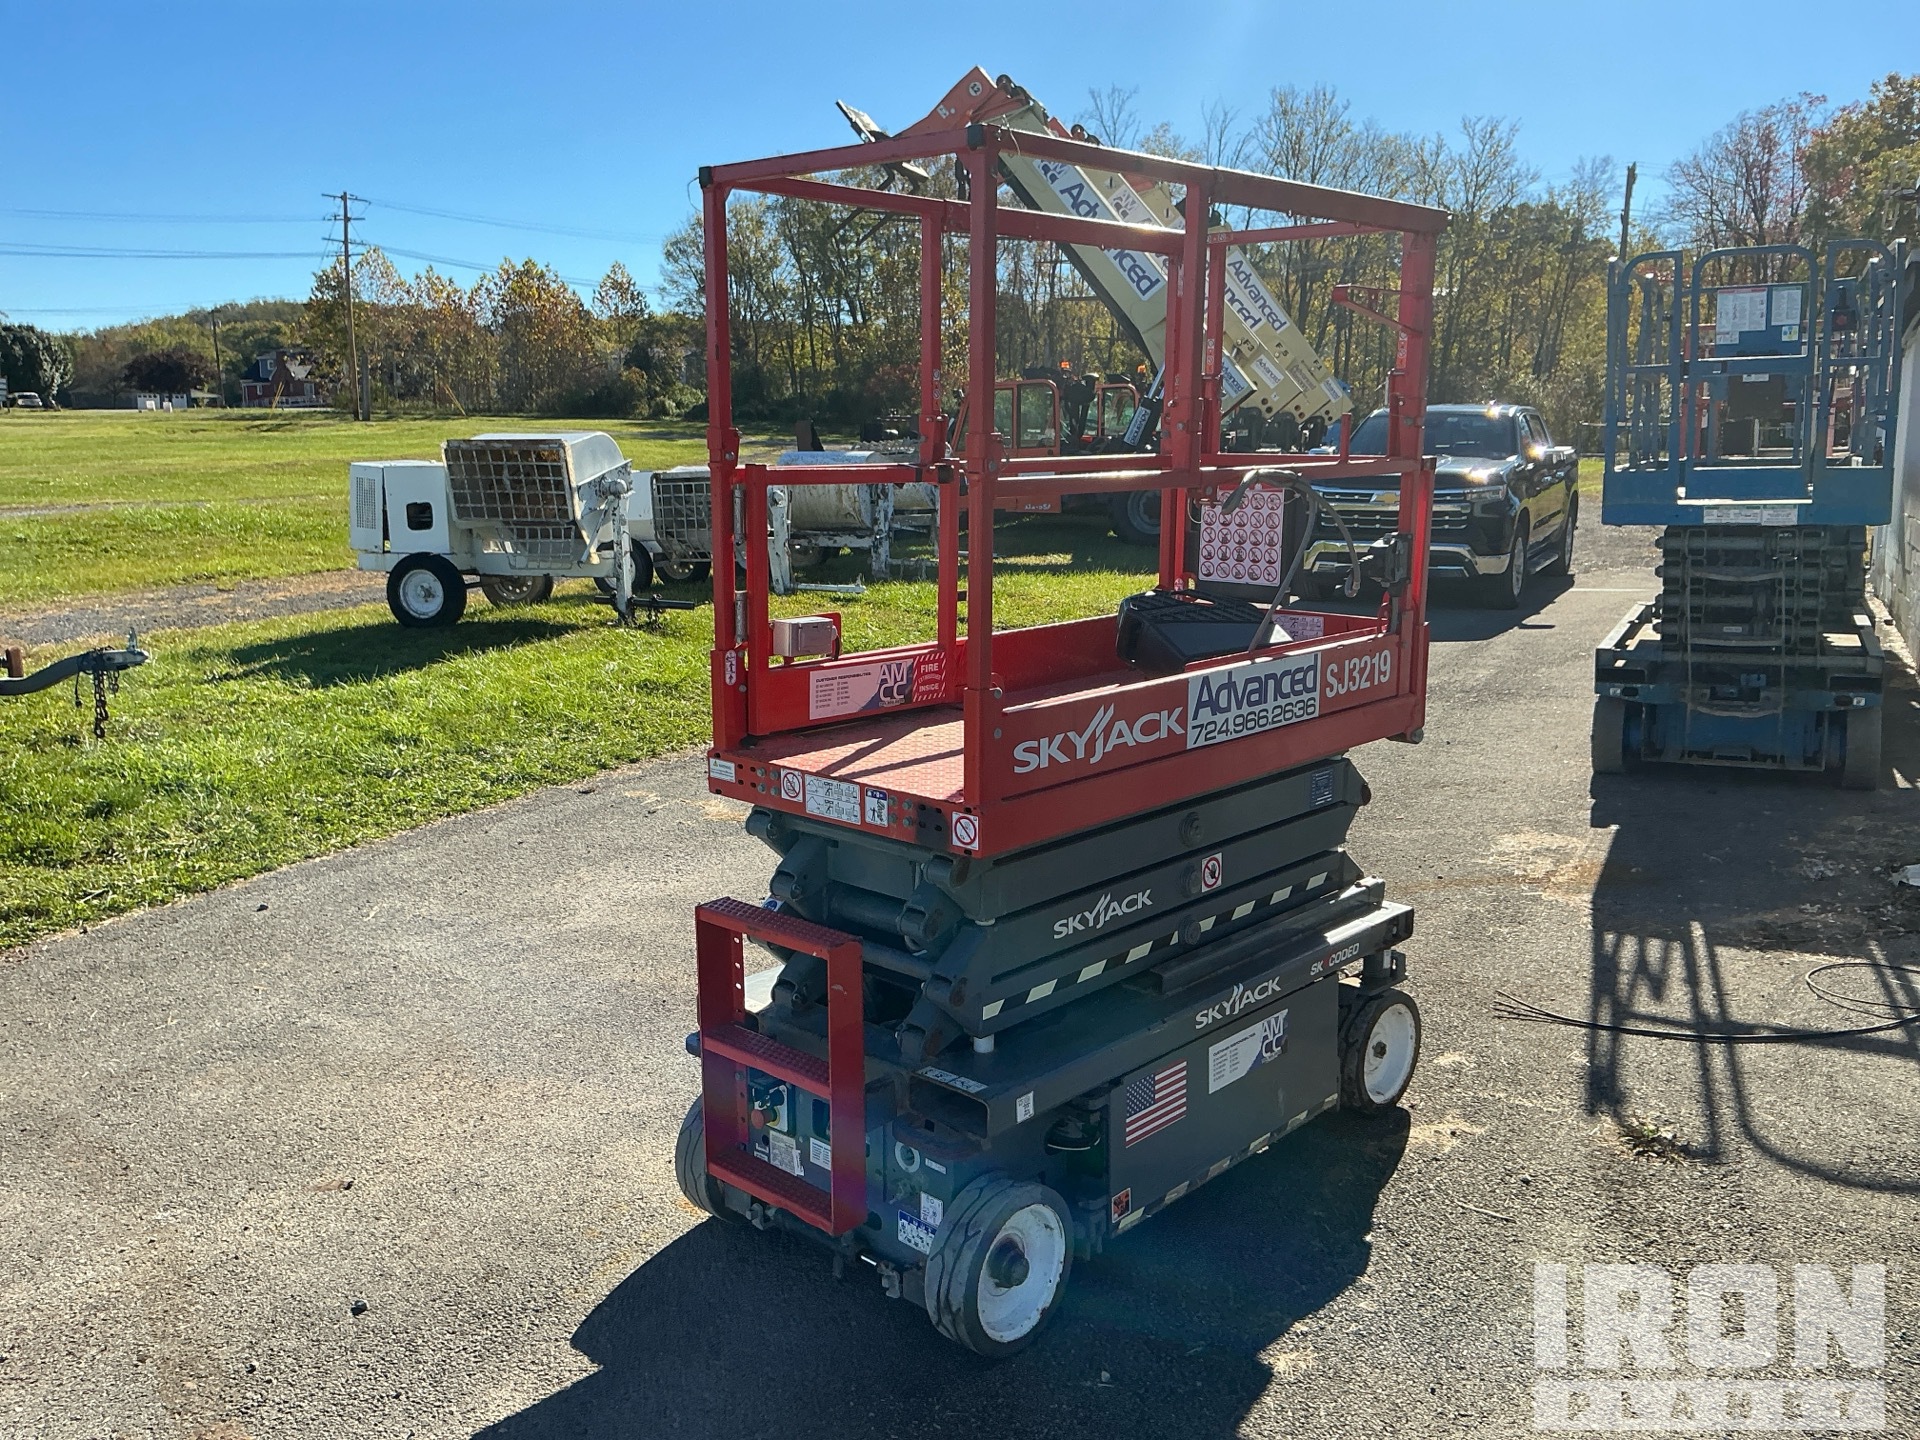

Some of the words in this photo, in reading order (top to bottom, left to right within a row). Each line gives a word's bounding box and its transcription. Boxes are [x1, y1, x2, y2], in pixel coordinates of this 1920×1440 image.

[1227, 260, 1287, 331] Advanced
[1243, 339, 1255, 352] F3
[1256, 358, 1280, 384] Advanced
[815, 675, 837, 683] CUSTOMER
[919, 683, 939, 692] INSIDE
[920, 662, 939, 674] FIRE
[1192, 653, 1318, 721] Advanced
[1325, 650, 1391, 699] SJ3219
[1012, 703, 1186, 774] SKYJACK
[1191, 697, 1317, 746] 724.966.2636
[1053, 888, 1154, 940] SKYJACK
[1195, 976, 1282, 1030] SKYJACK
